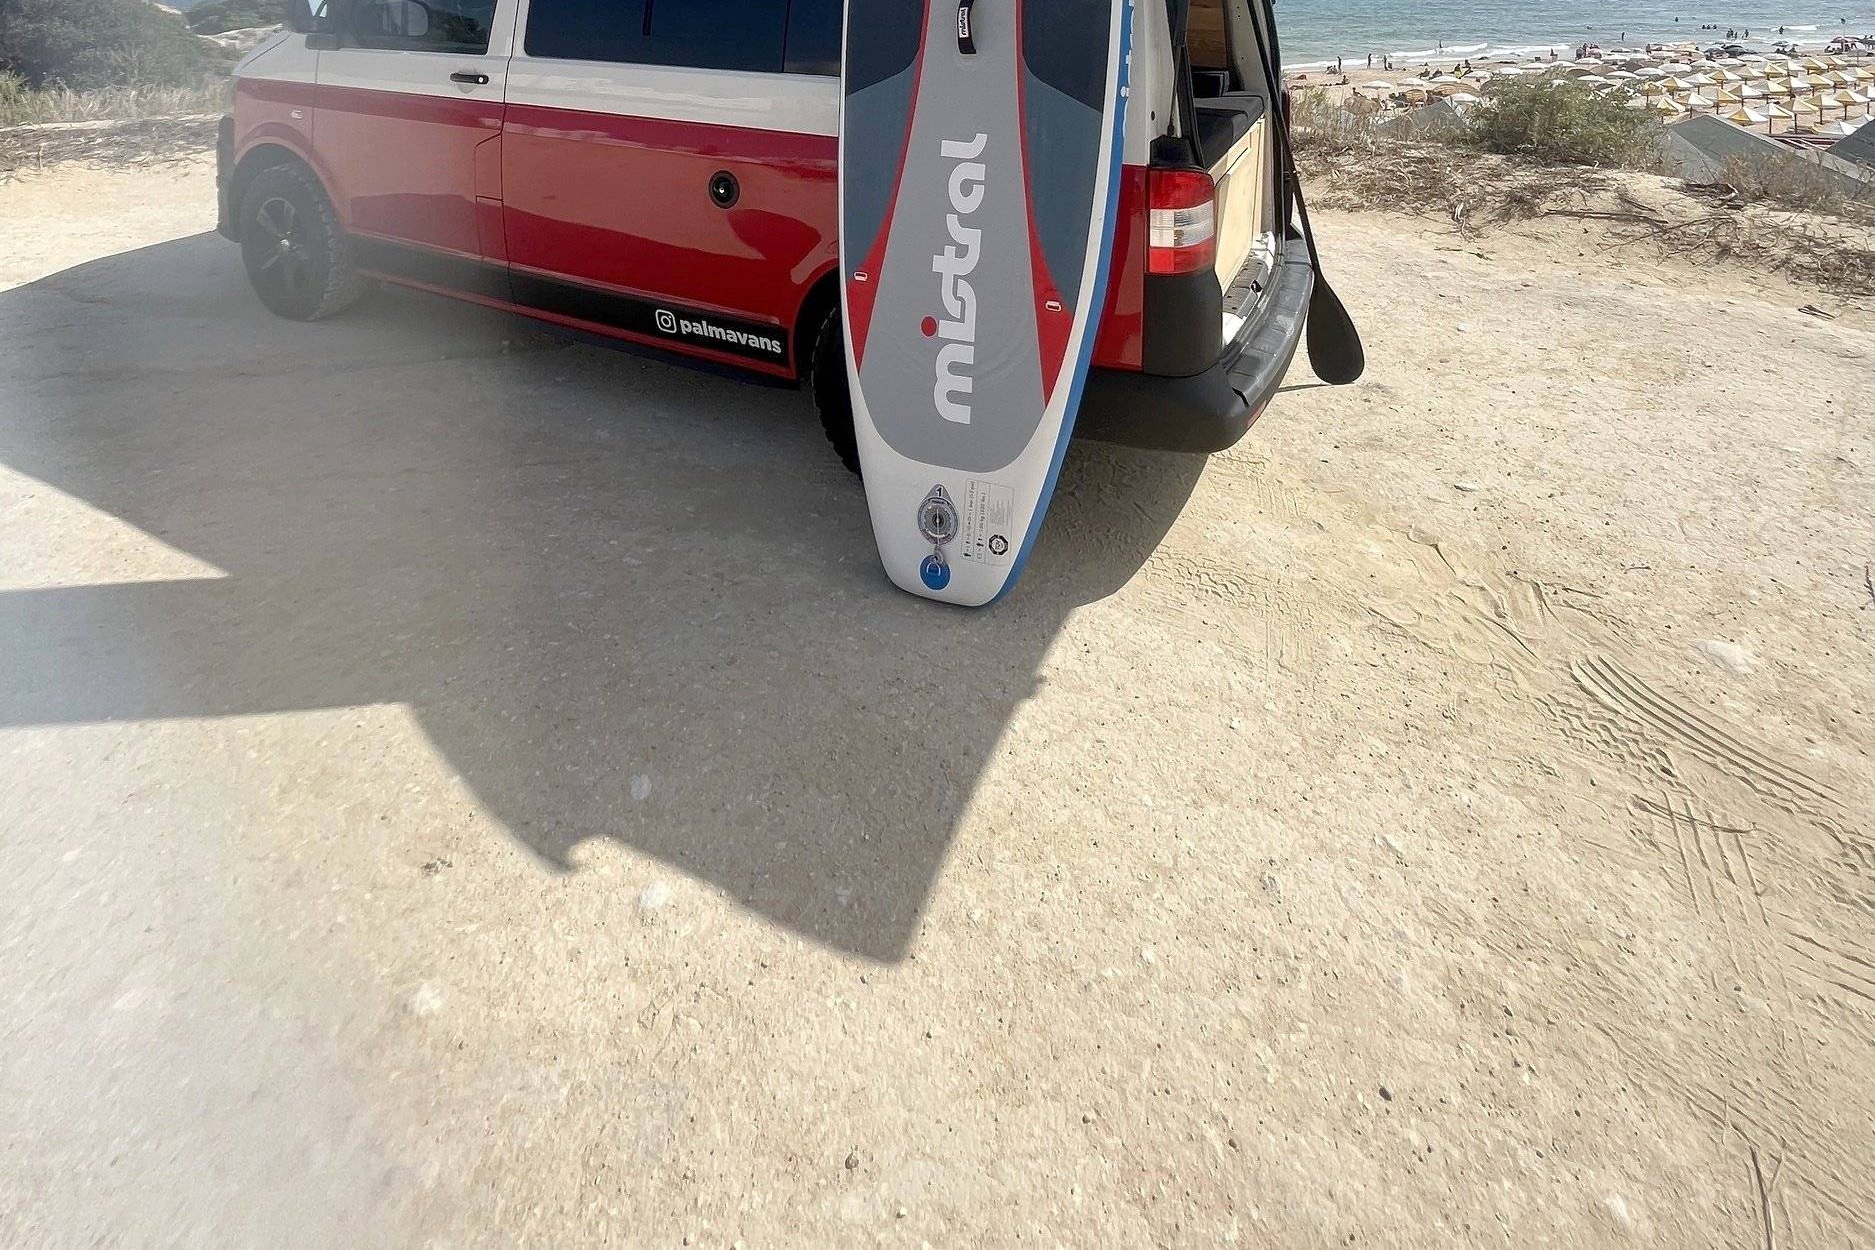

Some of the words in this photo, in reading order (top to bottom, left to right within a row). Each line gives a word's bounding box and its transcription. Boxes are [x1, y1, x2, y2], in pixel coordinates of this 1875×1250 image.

[920, 133, 988, 425] mistral
[679, 319, 782, 354] palmavans
[936, 487, 942, 497] 1
